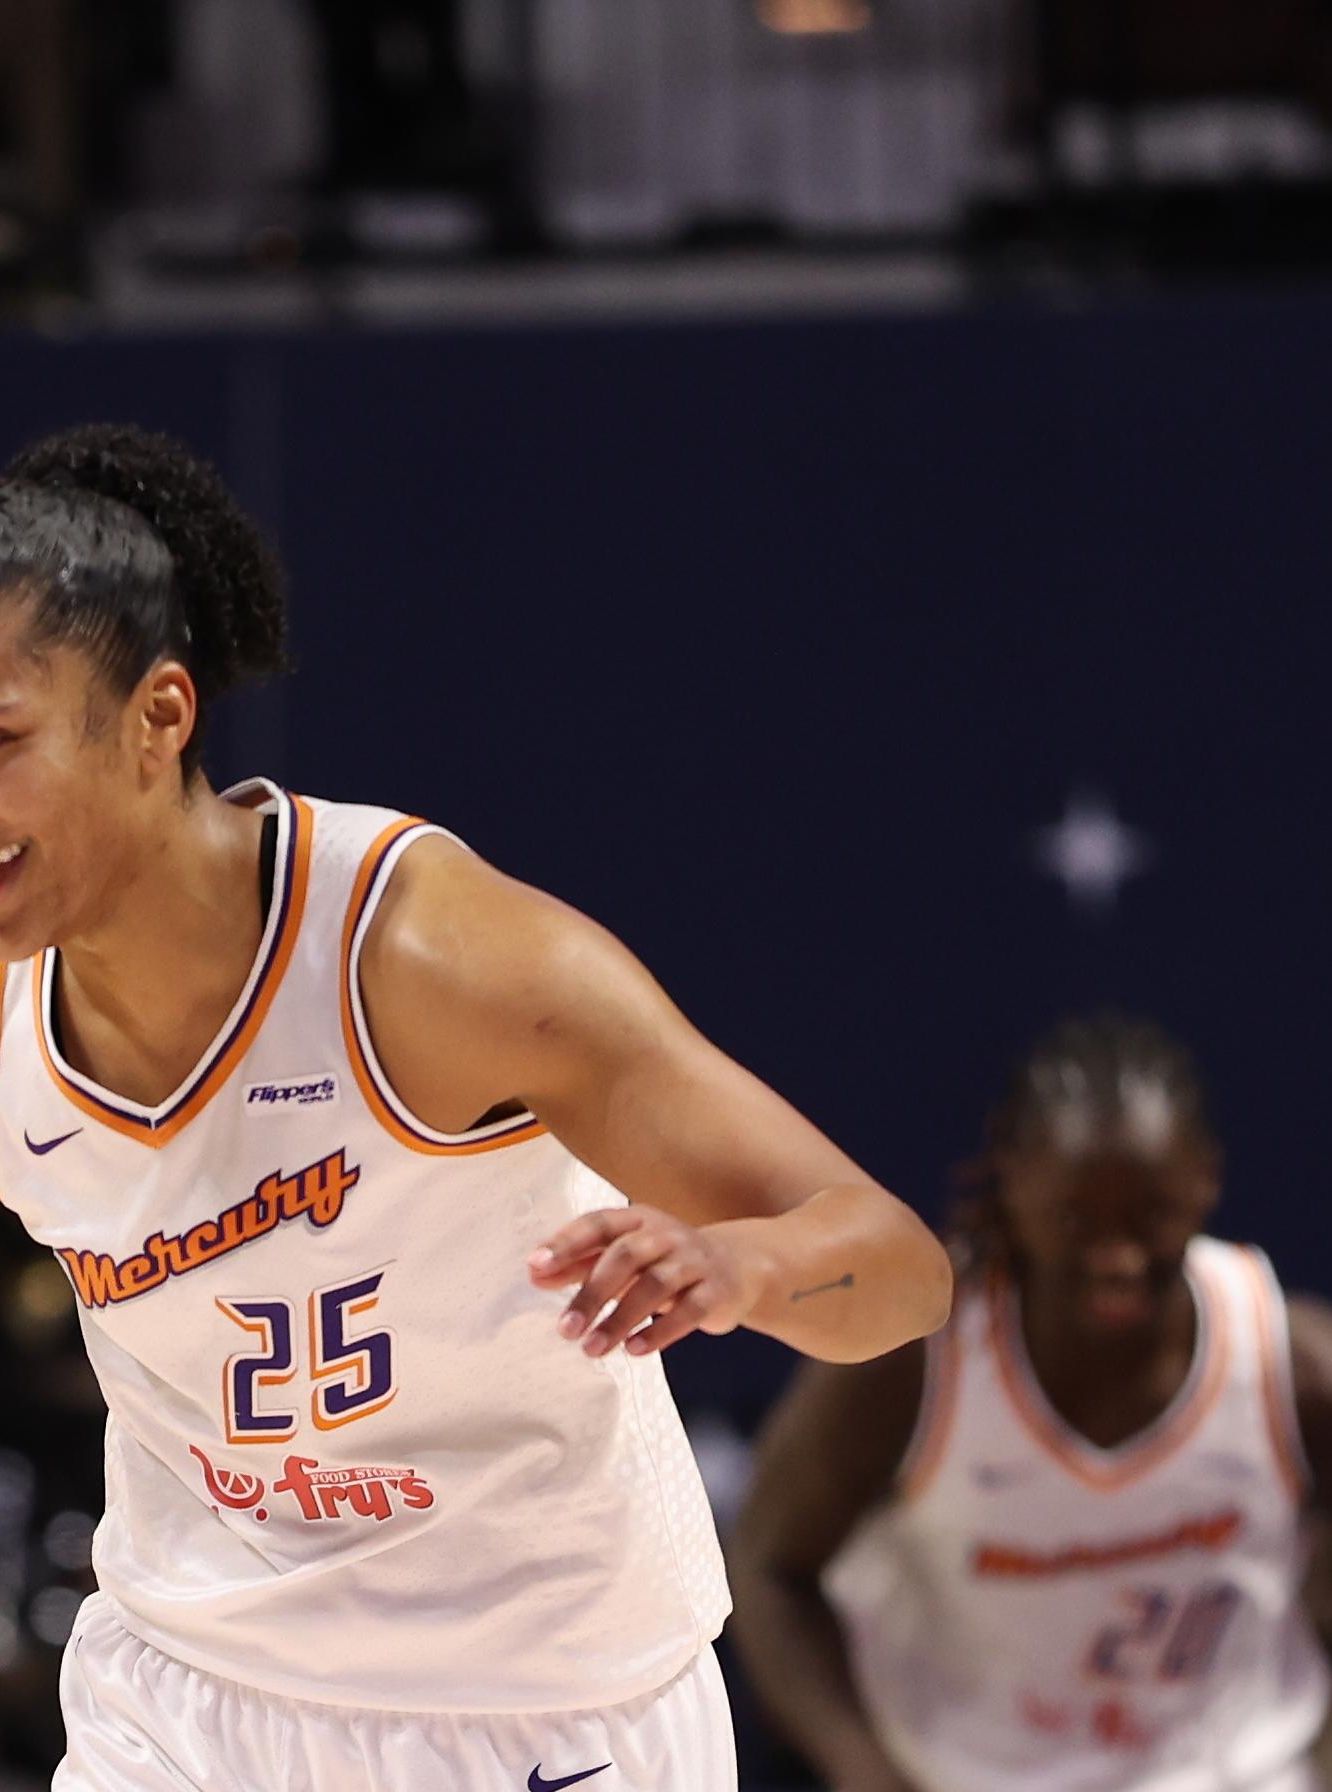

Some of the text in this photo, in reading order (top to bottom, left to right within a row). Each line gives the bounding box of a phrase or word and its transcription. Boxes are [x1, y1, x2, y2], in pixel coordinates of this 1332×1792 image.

[55, 1146, 361, 1309] Mercury
[215, 1270, 399, 1444] 25
[311, 1470, 351, 1484] FOOD
